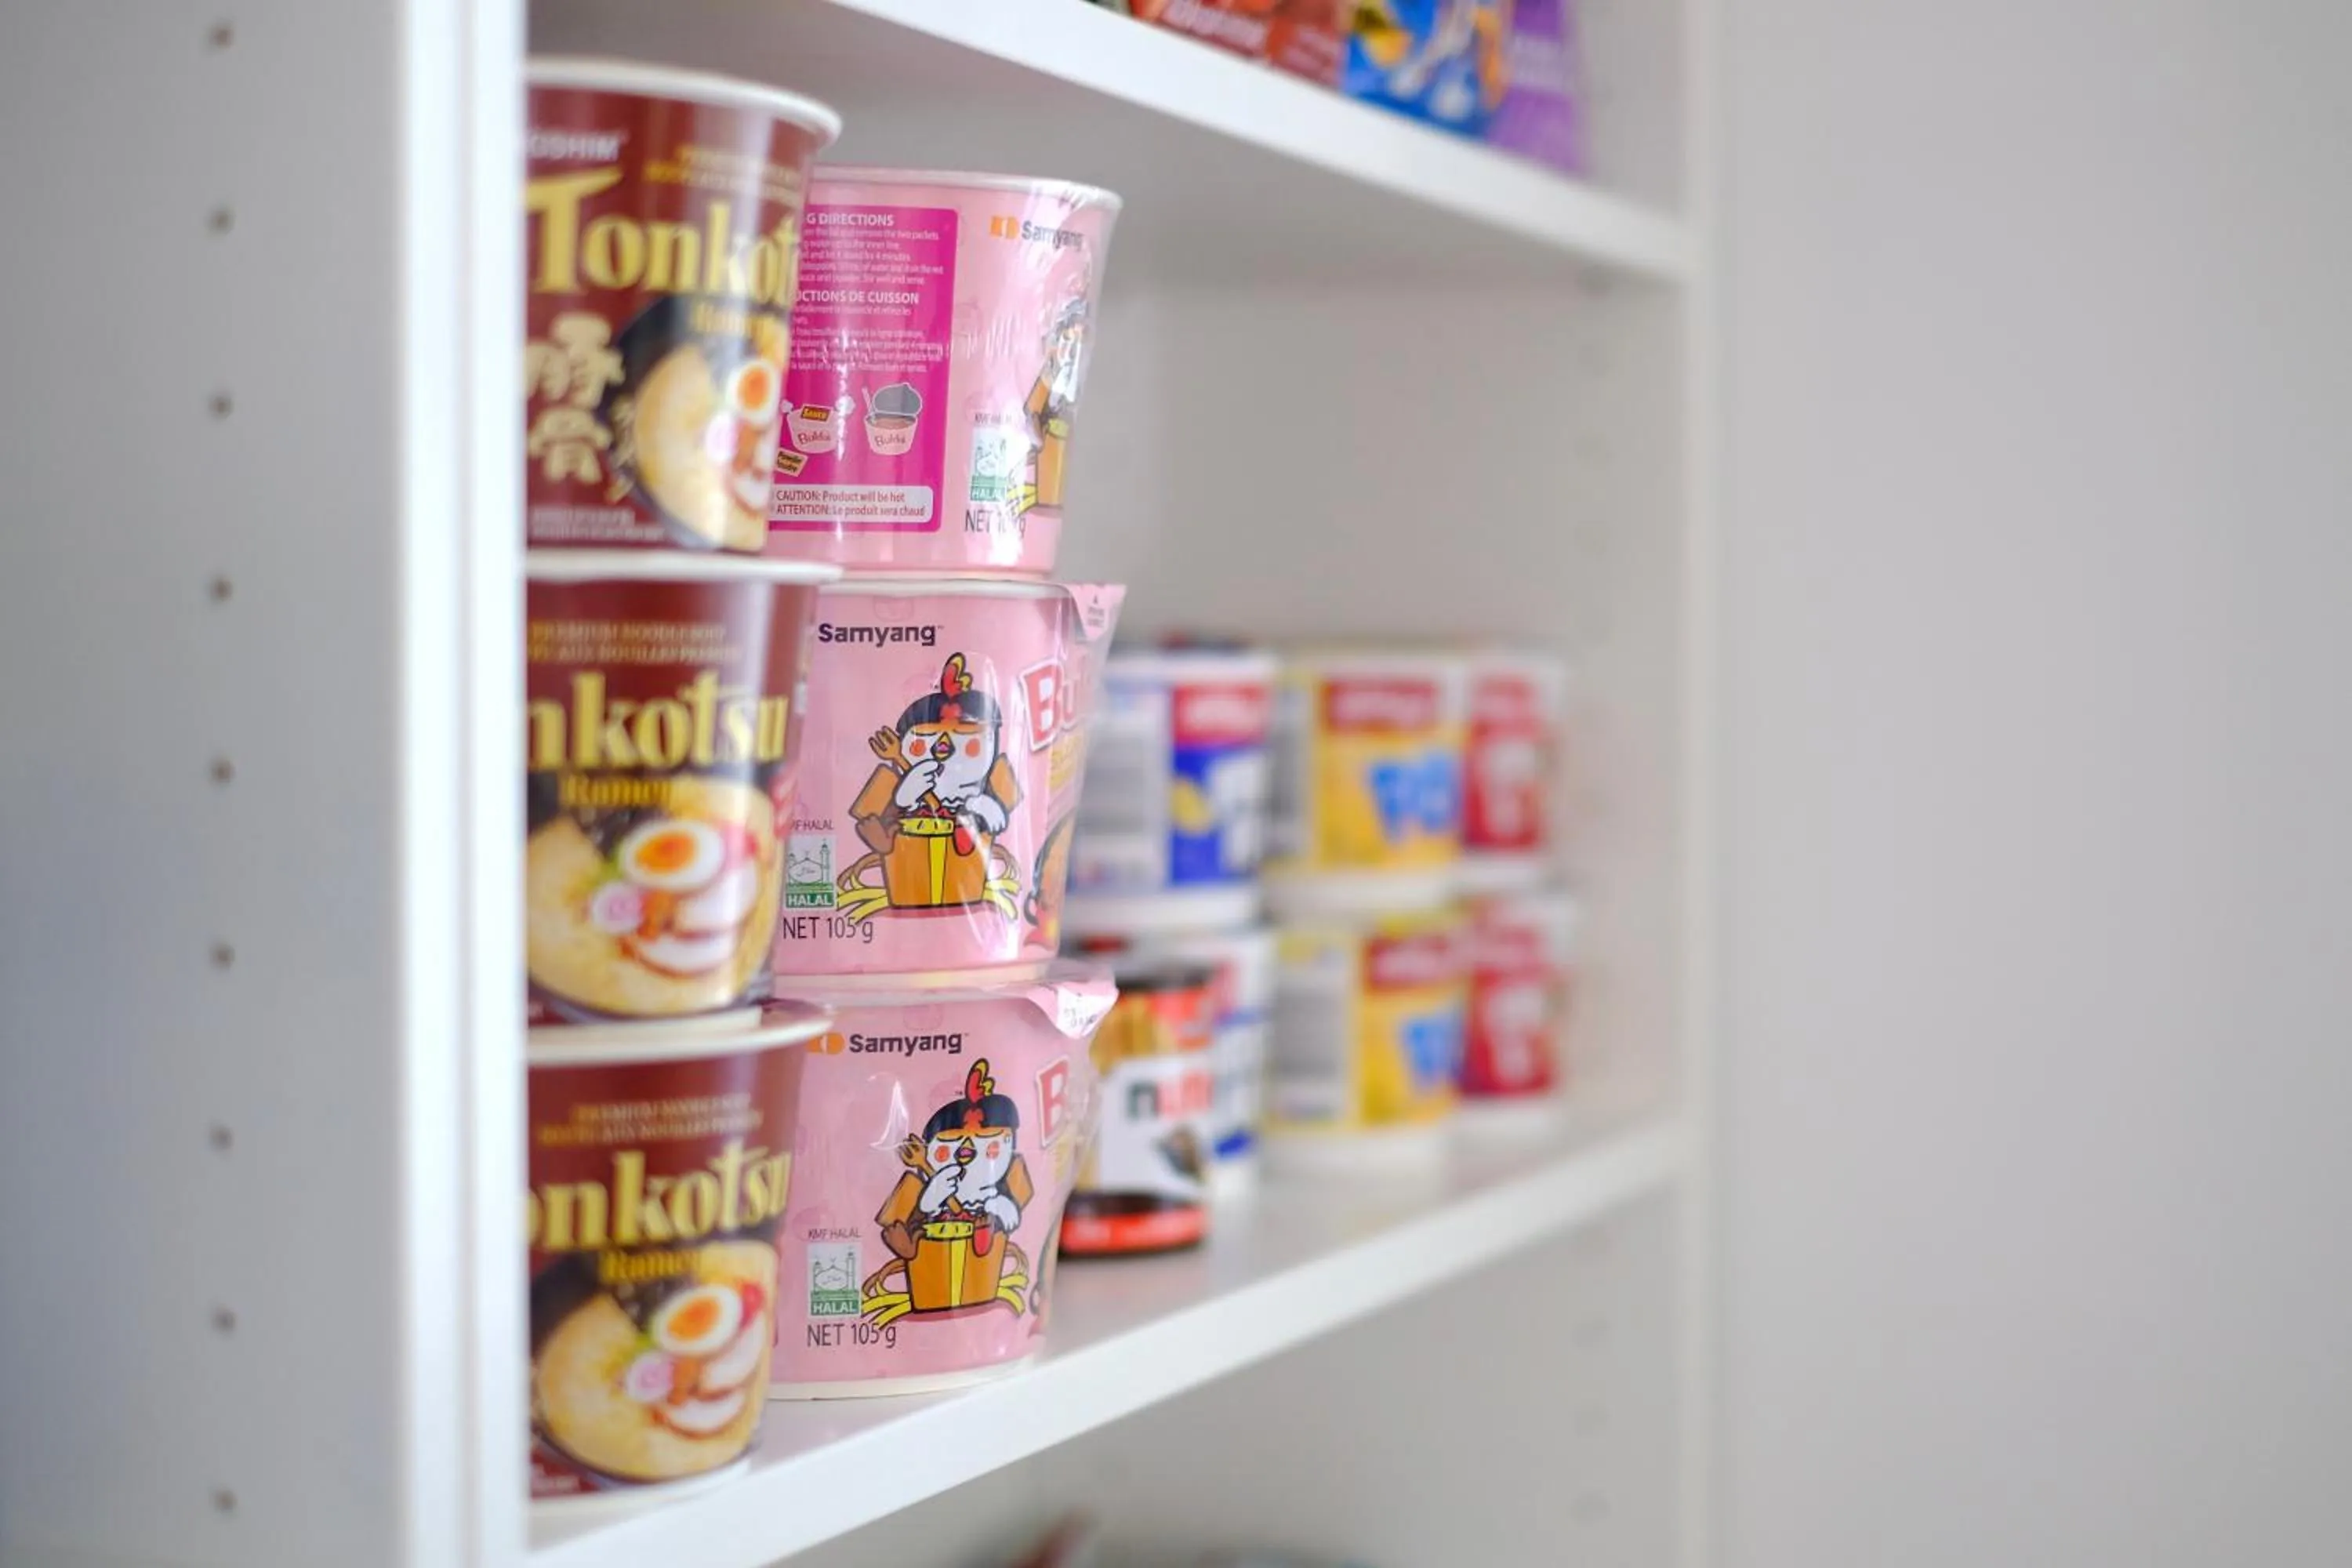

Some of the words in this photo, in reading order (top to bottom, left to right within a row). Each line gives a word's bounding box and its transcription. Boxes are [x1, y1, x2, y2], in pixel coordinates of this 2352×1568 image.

[818, 213, 895, 226] DIRECTIONS
[1021, 220, 1083, 251] Samyang
[848, 291, 865, 303] DE
[867, 291, 920, 304] CUISSON
[776, 489, 821, 502] CAUTION:
[823, 490, 858, 502] Product
[859, 491, 876, 502] will
[878, 491, 888, 503] be
[890, 492, 905, 503] hot
[777, 504, 829, 515] ATTENTION:
[844, 505, 880, 517] produit
[898, 506, 926, 517] chaud
[964, 510, 993, 533] NET
[818, 623, 938, 647] Samyang
[803, 818, 834, 830] HALAL
[787, 894, 833, 906] HALAL
[783, 916, 820, 940] NET
[826, 916, 856, 939] 105
[862, 920, 873, 943] g
[849, 1033, 964, 1057] Samyang
[527, 1134, 793, 1253] nkotsu
[829, 1228, 862, 1239] HALAL
[813, 1301, 858, 1314] HALAL
[807, 1323, 845, 1348] NET
[850, 1323, 880, 1345] 105
[885, 1325, 896, 1349] g
